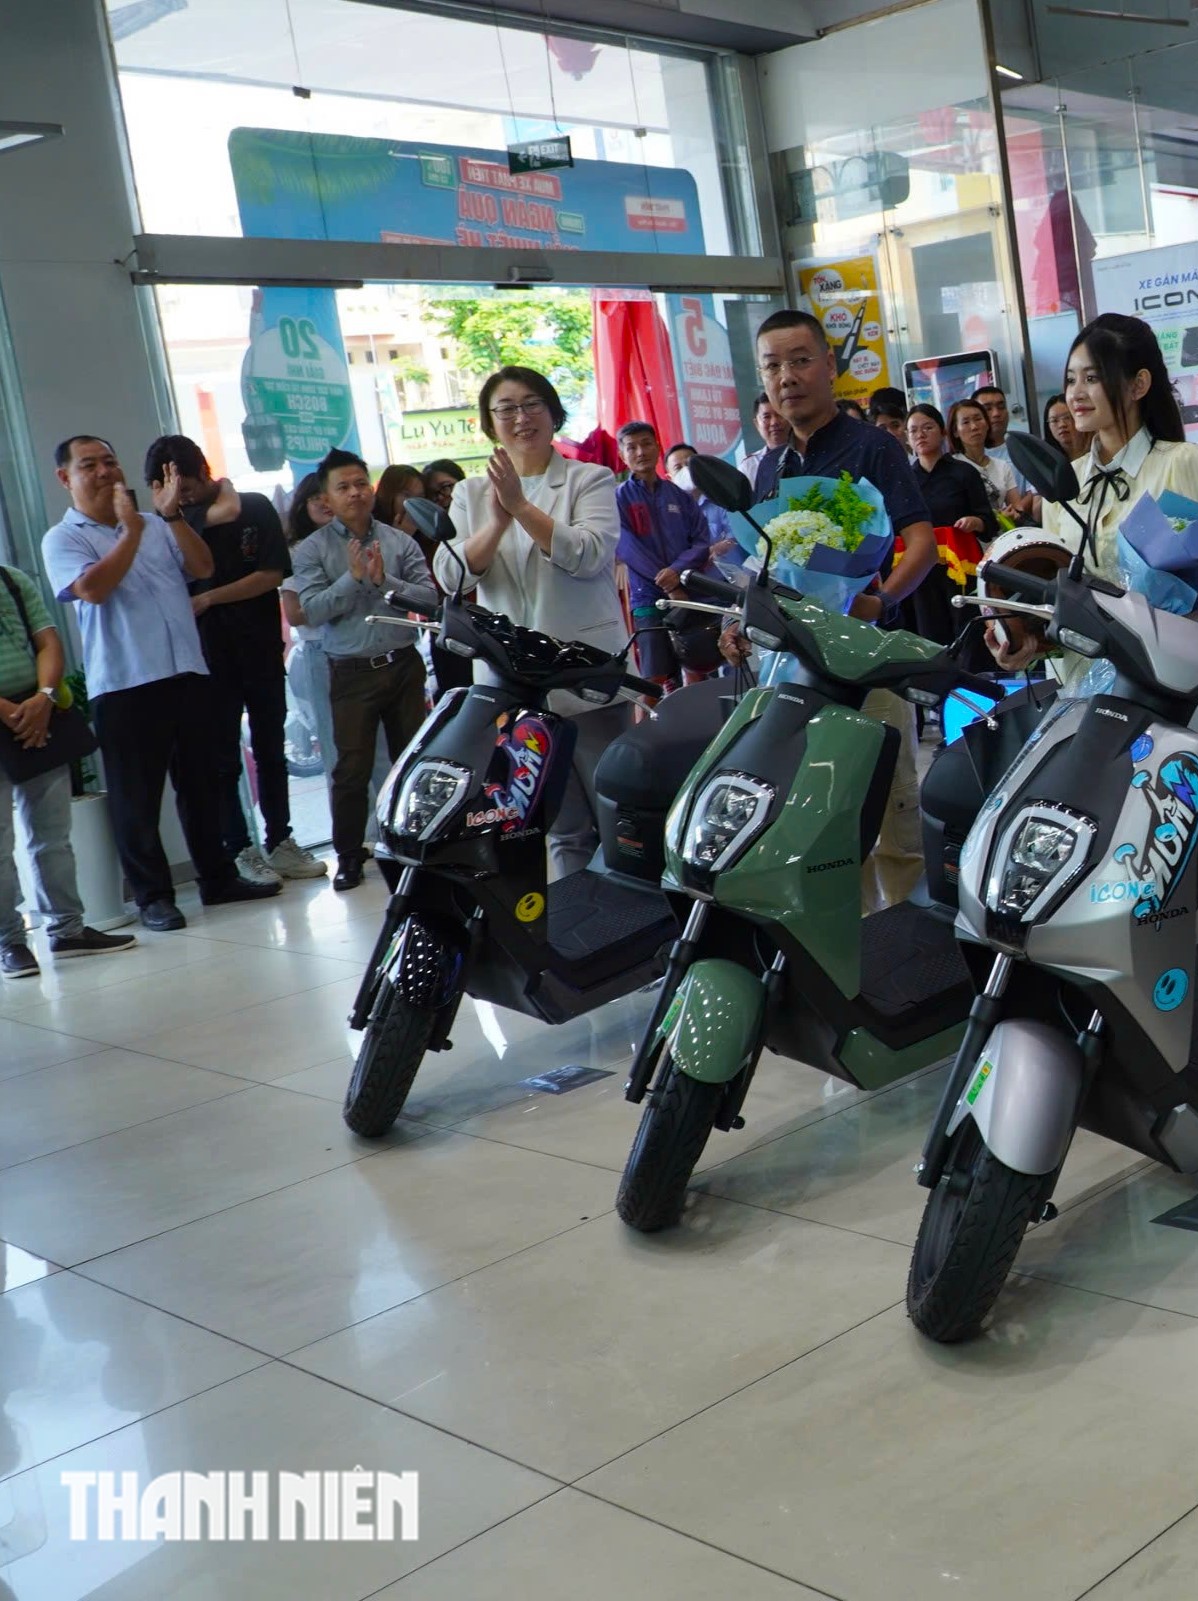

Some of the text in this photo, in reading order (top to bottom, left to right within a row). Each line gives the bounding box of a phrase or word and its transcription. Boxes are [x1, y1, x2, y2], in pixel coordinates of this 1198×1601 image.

[1139, 279, 1153, 290] XE
[777, 692, 805, 704] HONDA
[1095, 707, 1129, 722] HONDA
[500, 826, 542, 842] HONDA
[806, 857, 855, 875] HONDA
[1136, 905, 1190, 927] HONDA
